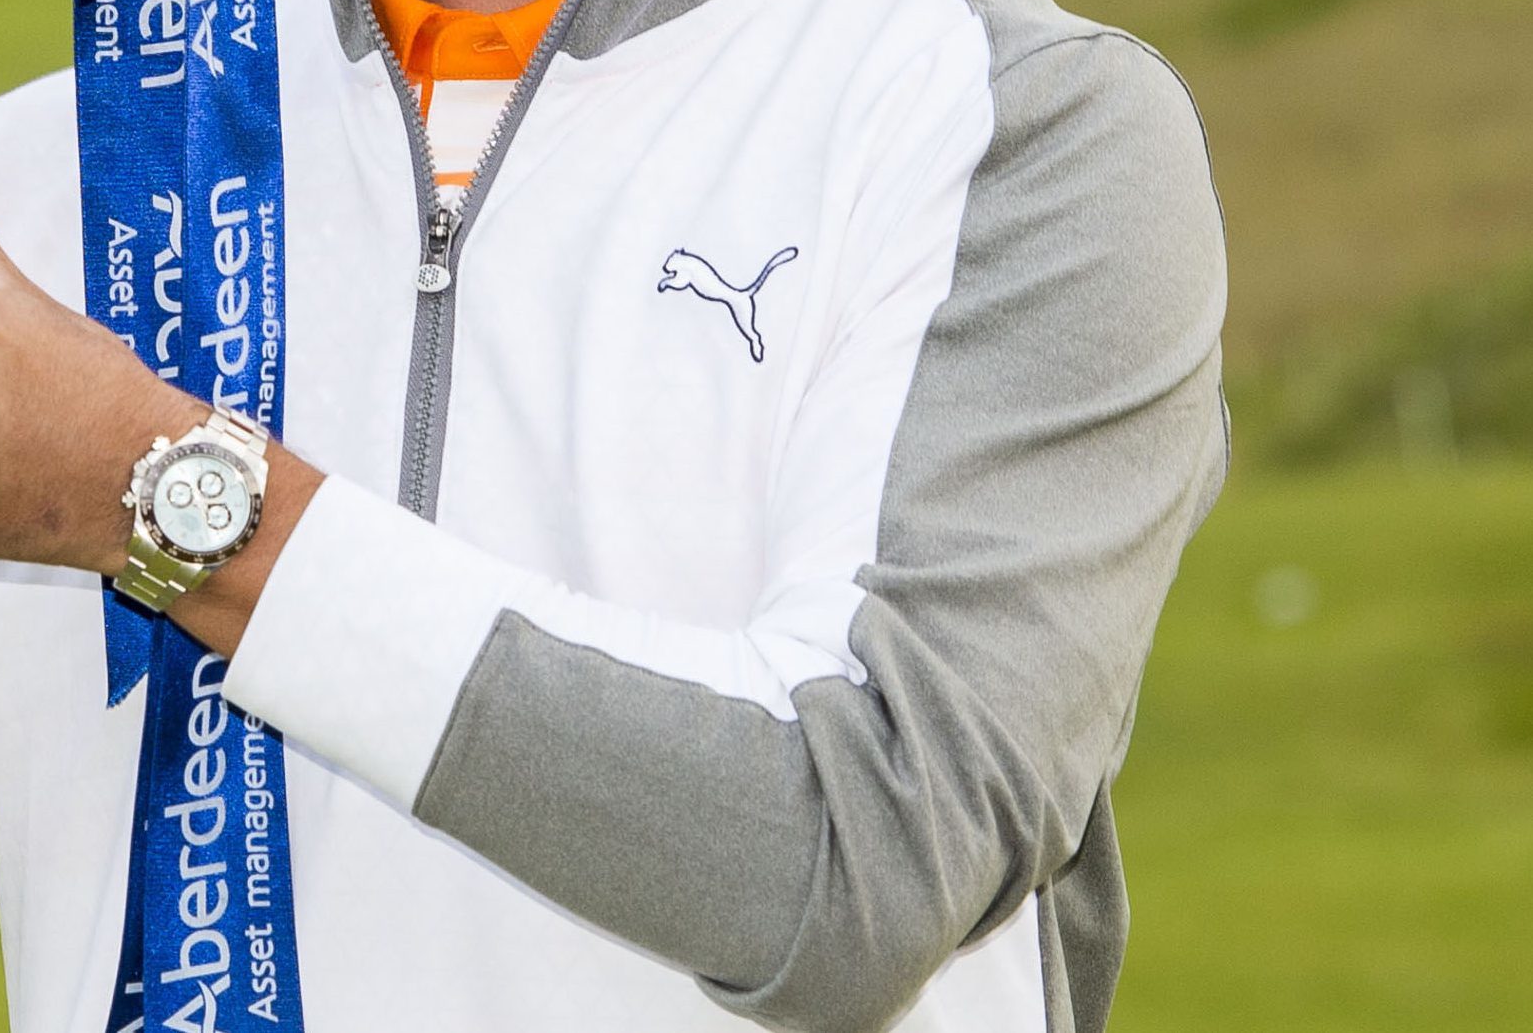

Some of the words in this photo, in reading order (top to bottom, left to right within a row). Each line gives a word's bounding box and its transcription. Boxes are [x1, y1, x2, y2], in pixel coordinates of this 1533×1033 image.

[108, 217, 139, 318] Asset
[200, 175, 250, 412] rdeen
[243, 713, 275, 908] manageme
[248, 924, 280, 1023] Asset
